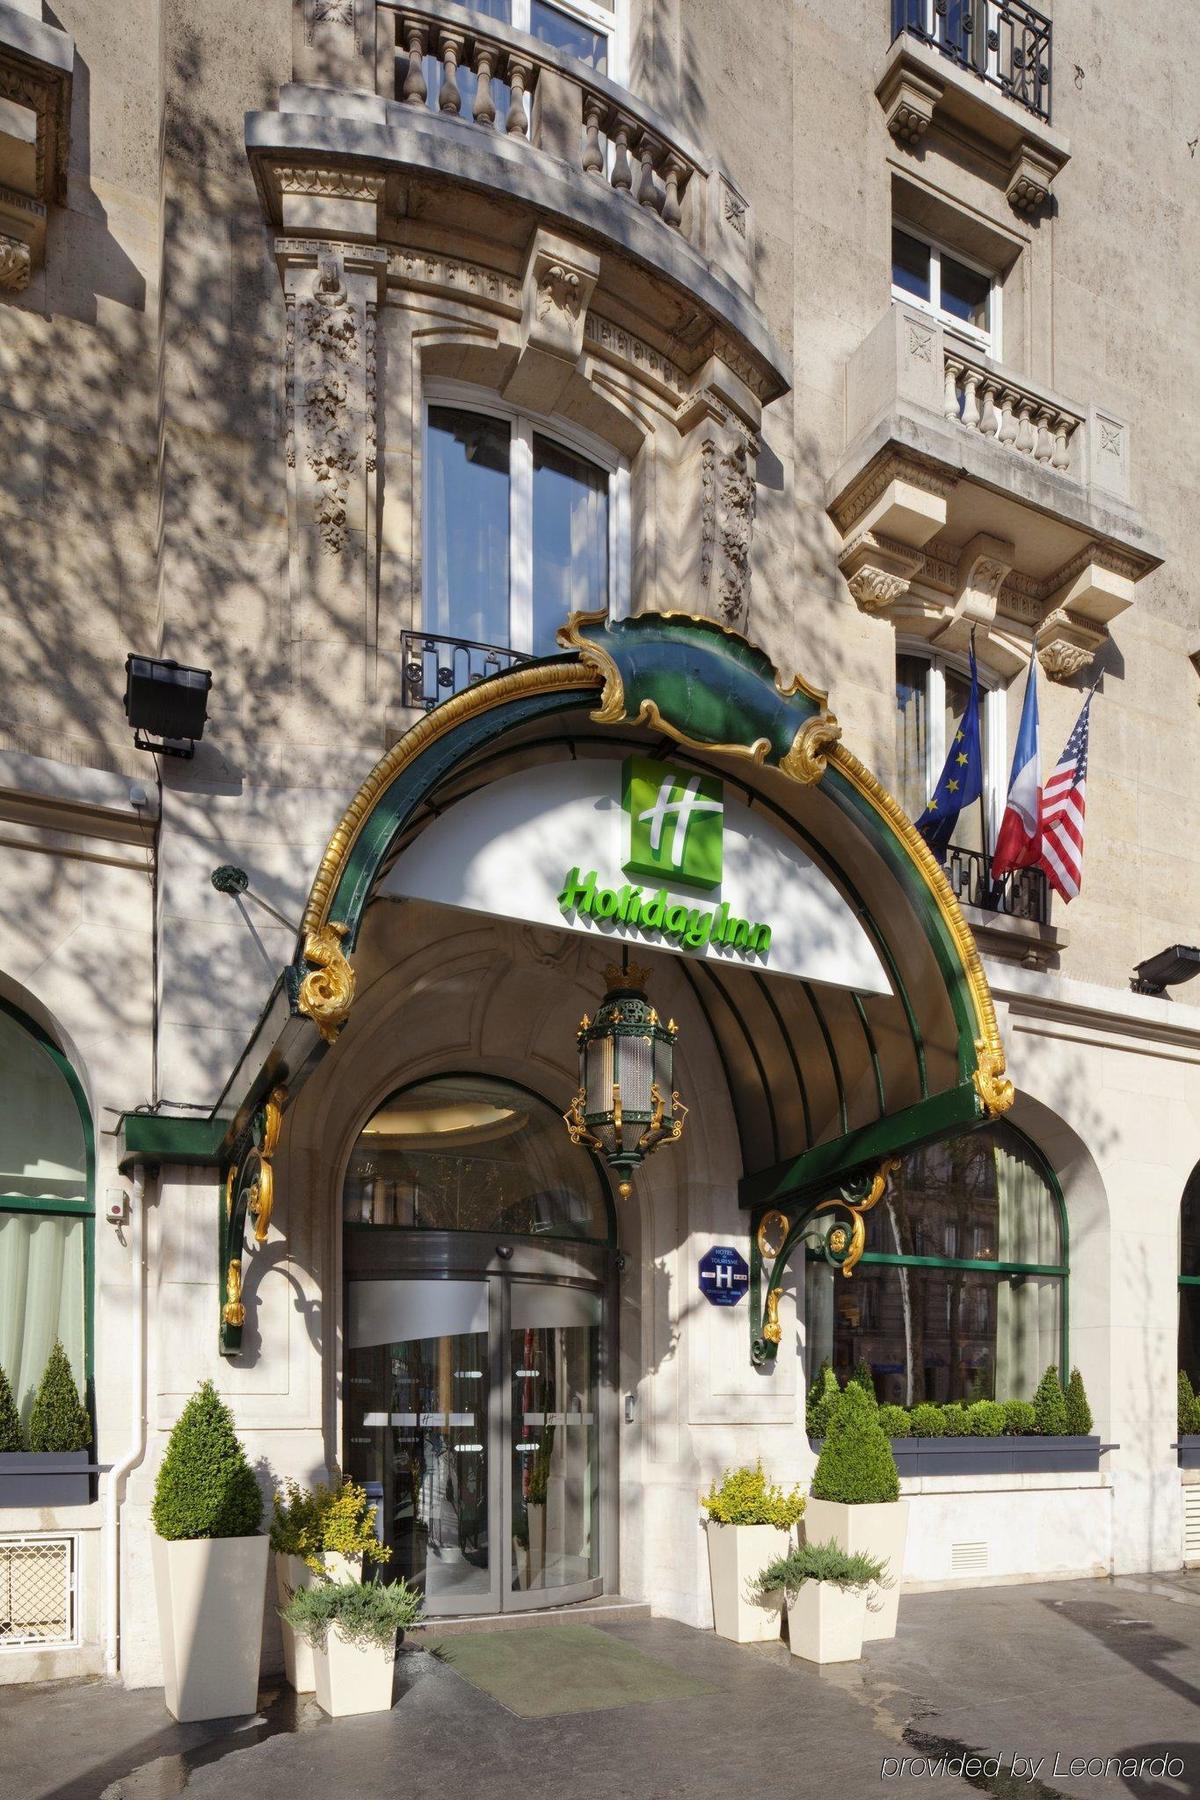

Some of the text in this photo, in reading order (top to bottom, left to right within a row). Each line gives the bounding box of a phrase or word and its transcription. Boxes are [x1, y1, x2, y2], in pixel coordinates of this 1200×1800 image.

[557, 866, 772, 954] Holiday Inn
[716, 1265, 733, 1288] H
